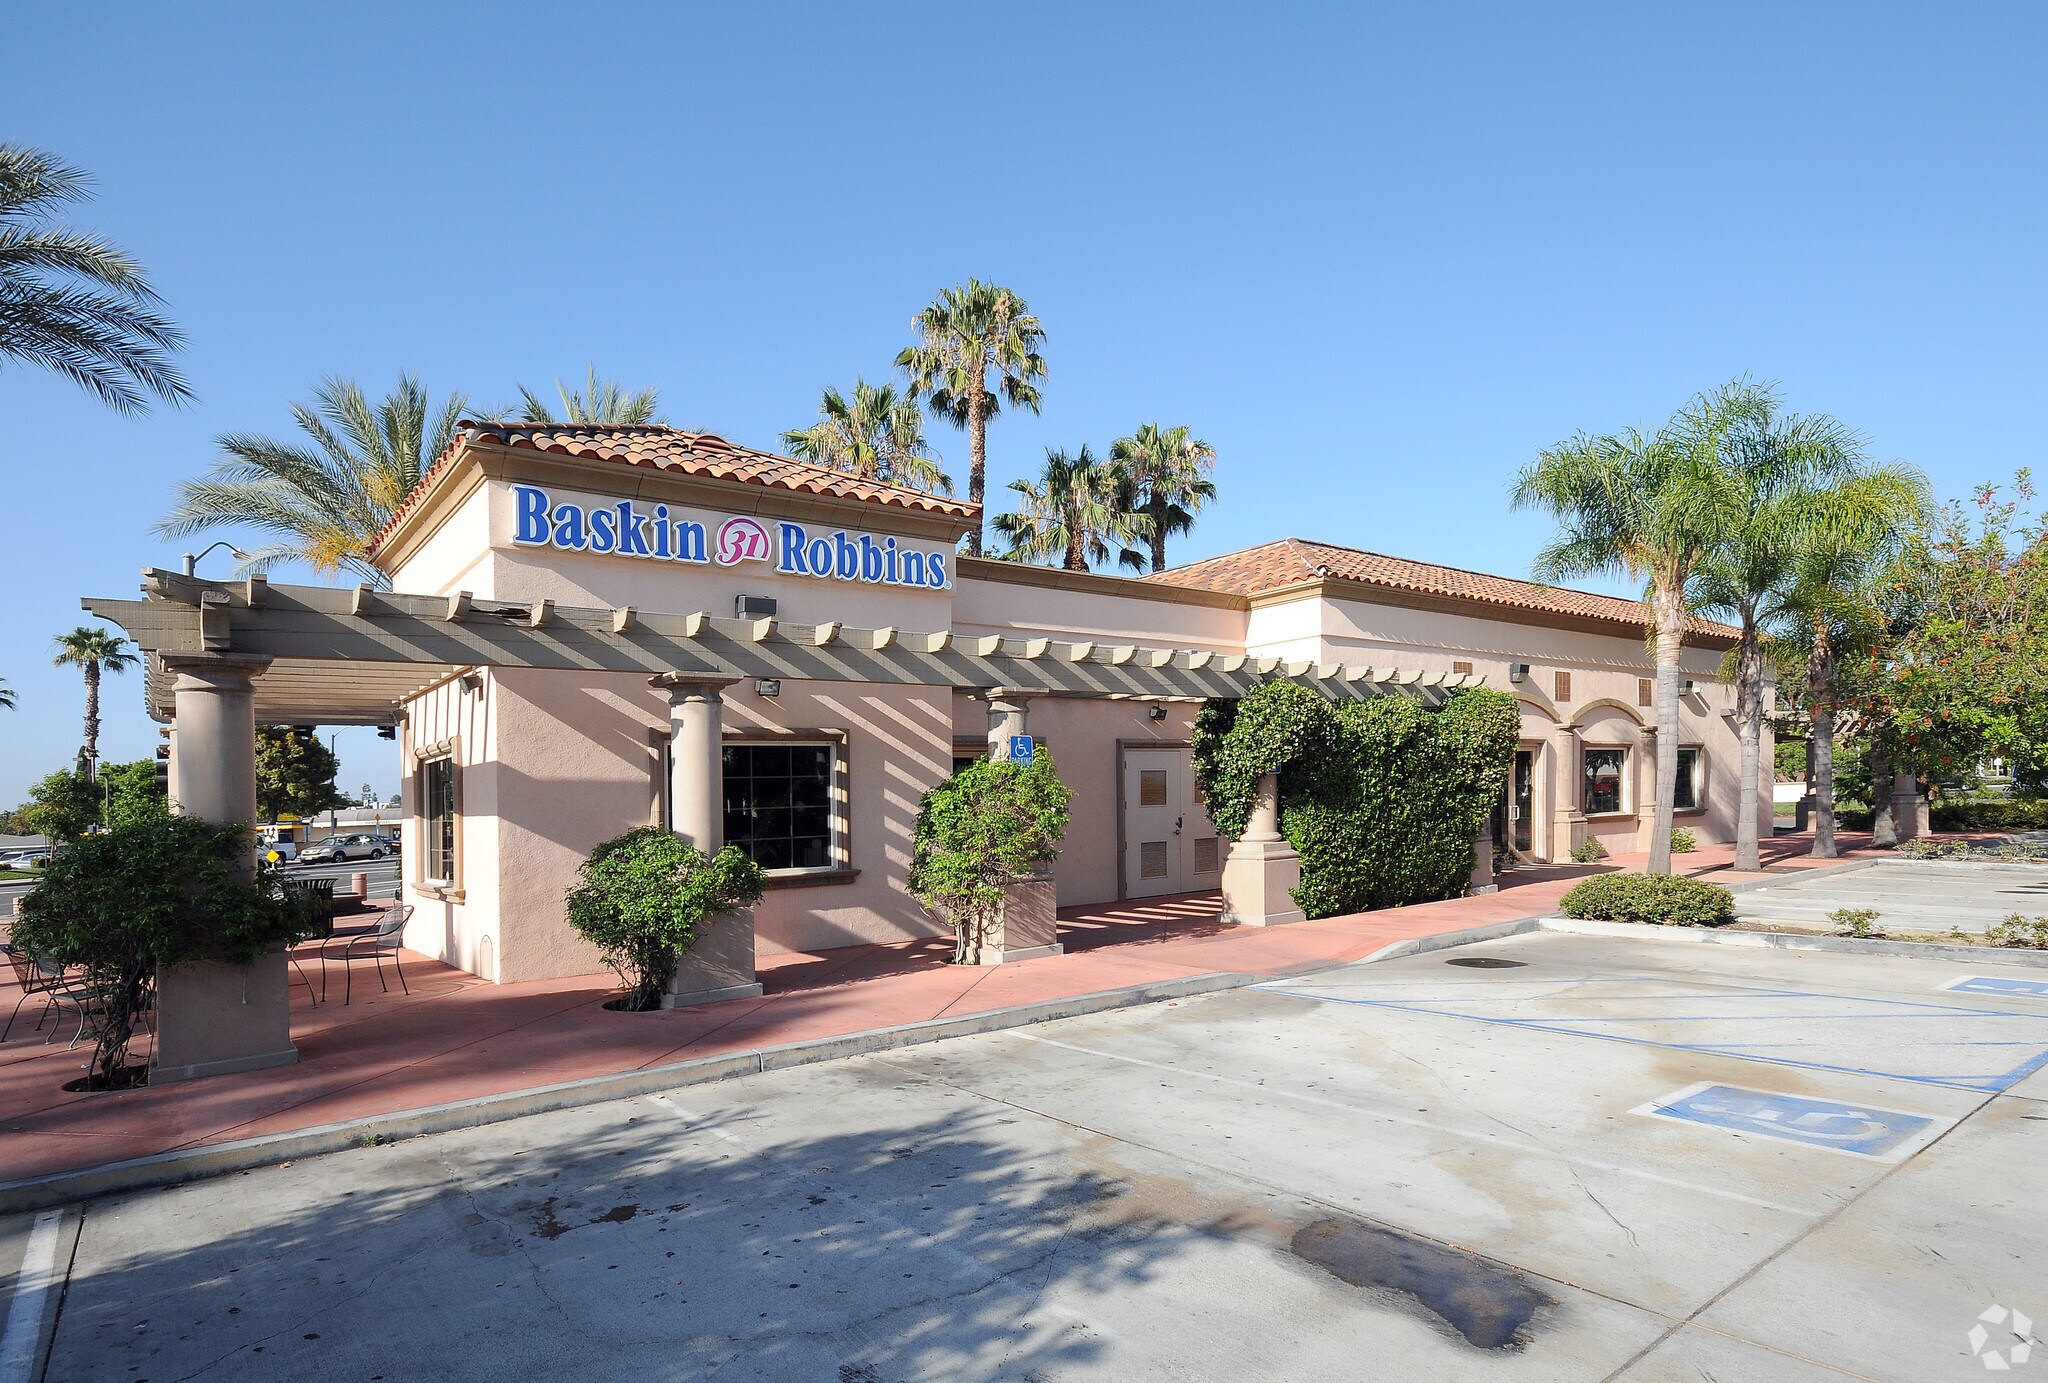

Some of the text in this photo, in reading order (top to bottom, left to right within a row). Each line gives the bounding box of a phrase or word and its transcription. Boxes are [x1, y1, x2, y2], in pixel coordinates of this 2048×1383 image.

[512, 485, 946, 588] Baskin 31 Robbins
